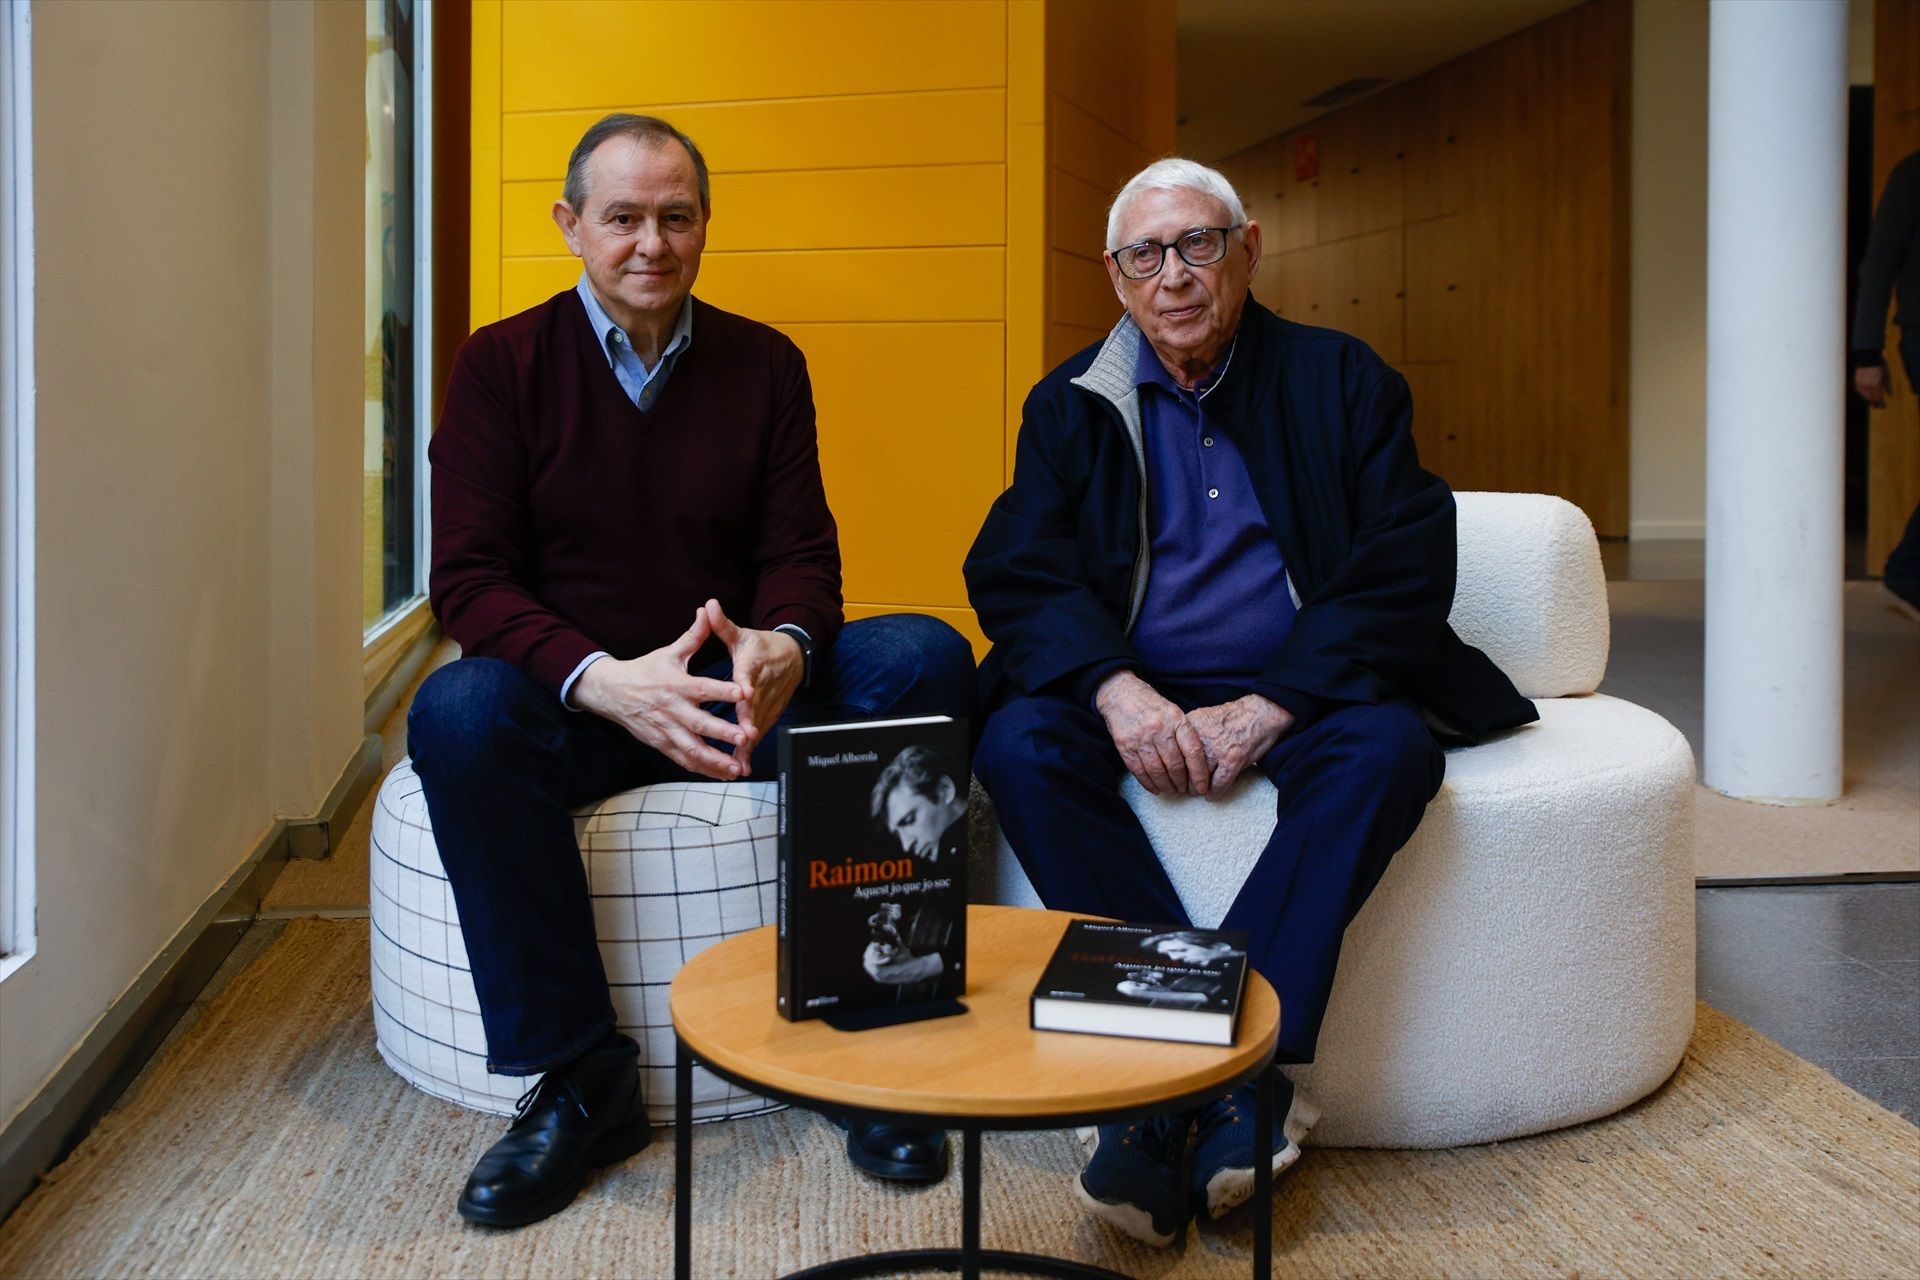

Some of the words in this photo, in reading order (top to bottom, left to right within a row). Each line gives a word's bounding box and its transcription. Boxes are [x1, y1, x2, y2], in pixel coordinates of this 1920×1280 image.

[809, 857, 913, 889] Raimon
[854, 884, 889, 899] Aquest
[890, 882, 901, 896] jo
[902, 880, 921, 894] que
[922, 878, 933, 892] jo
